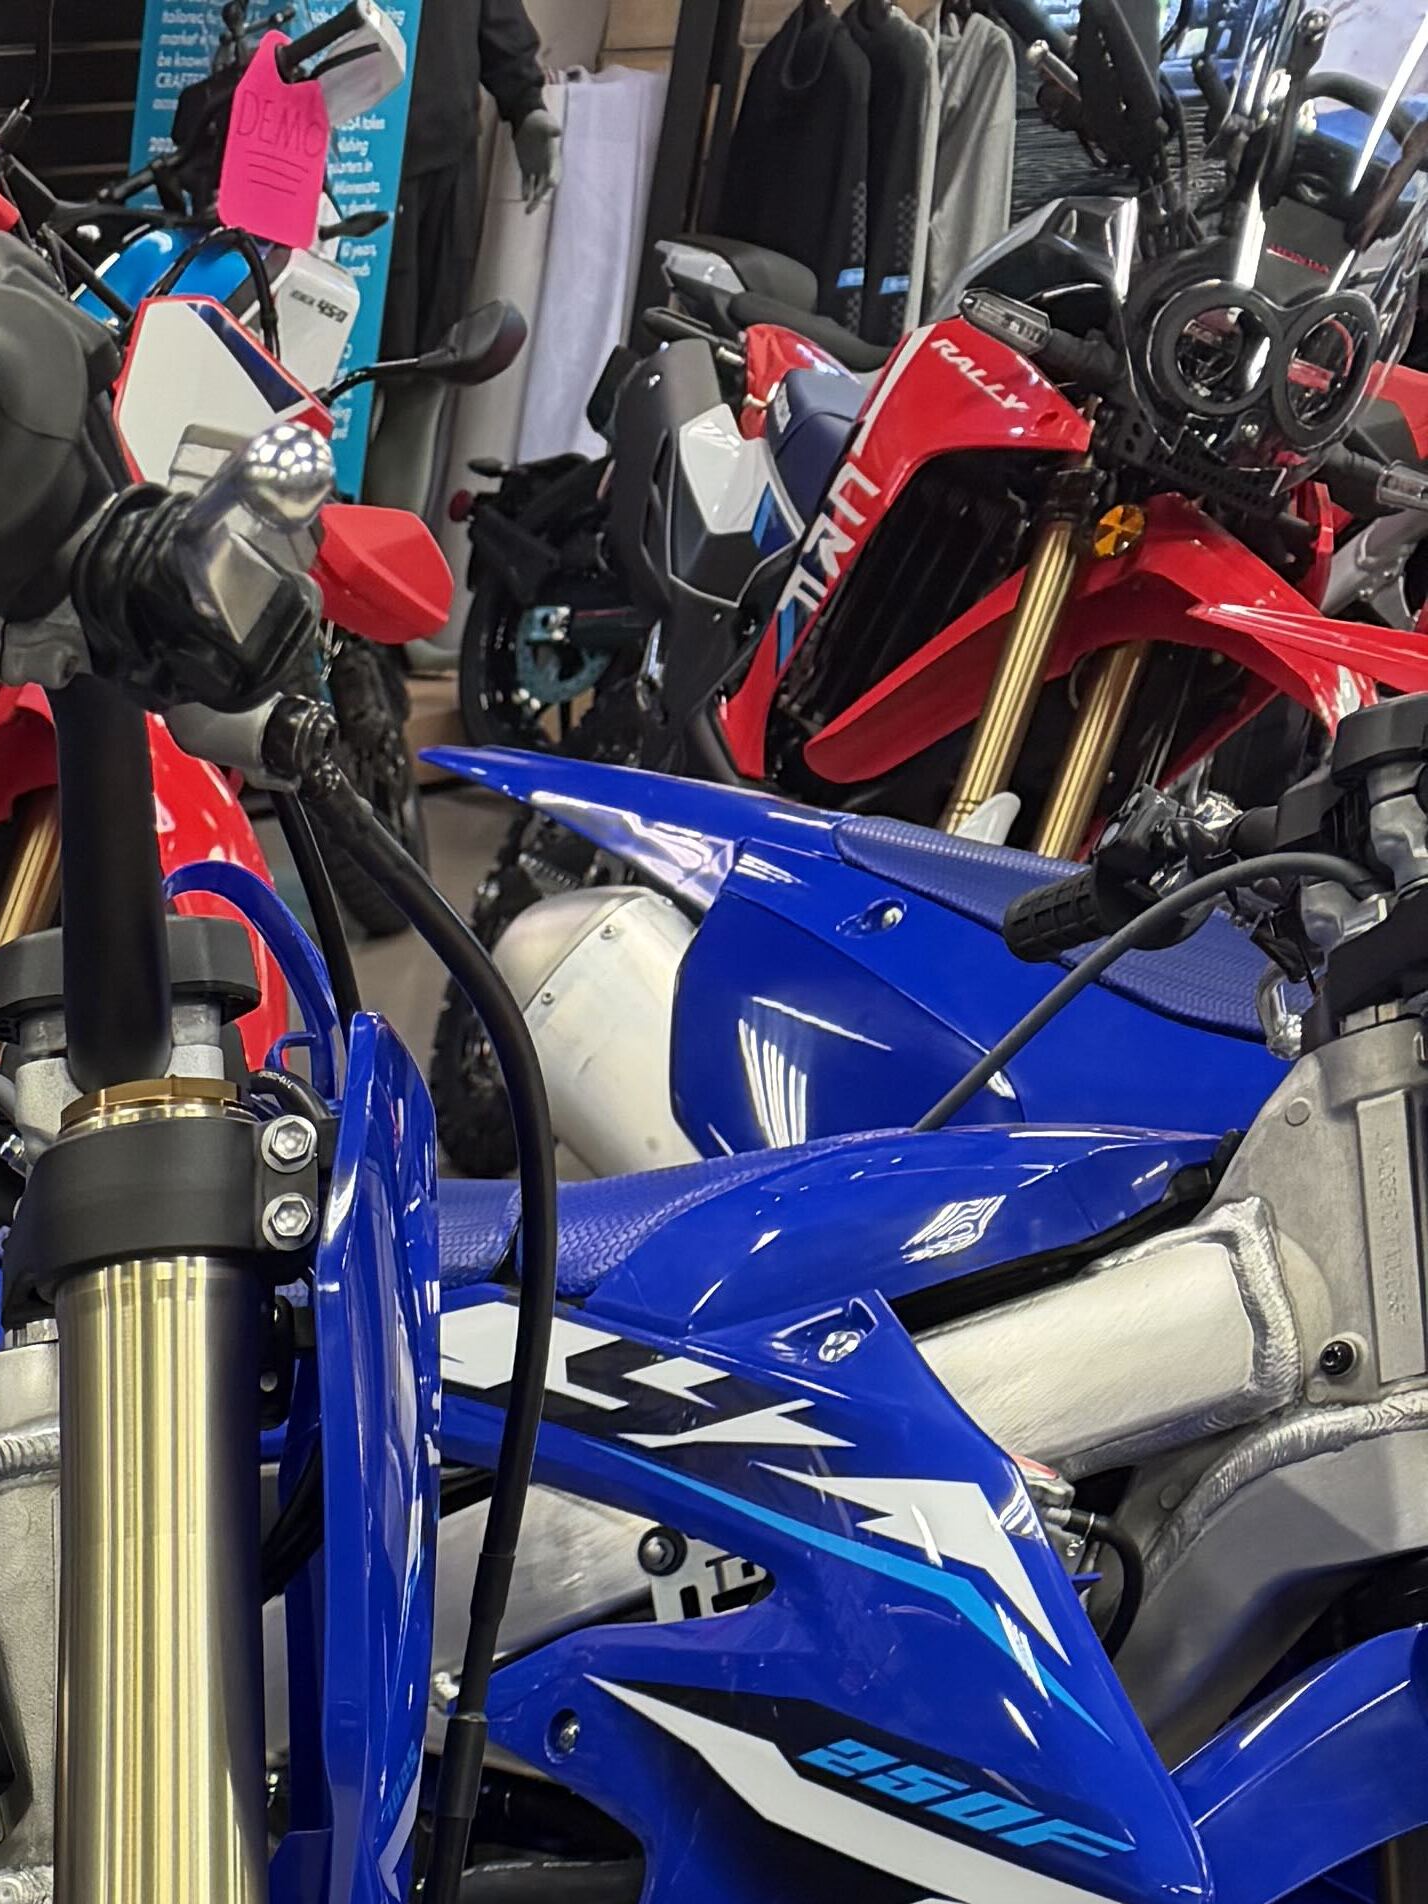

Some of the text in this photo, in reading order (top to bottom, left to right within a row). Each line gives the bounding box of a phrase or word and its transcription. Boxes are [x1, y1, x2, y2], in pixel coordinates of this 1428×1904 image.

[236, 90, 327, 157] DEMO
[316, 300, 349, 324] 450
[930, 338, 1030, 412] RALLY
[776, 461, 882, 612] CRF
[798, 1738, 1137, 1860] 250F
